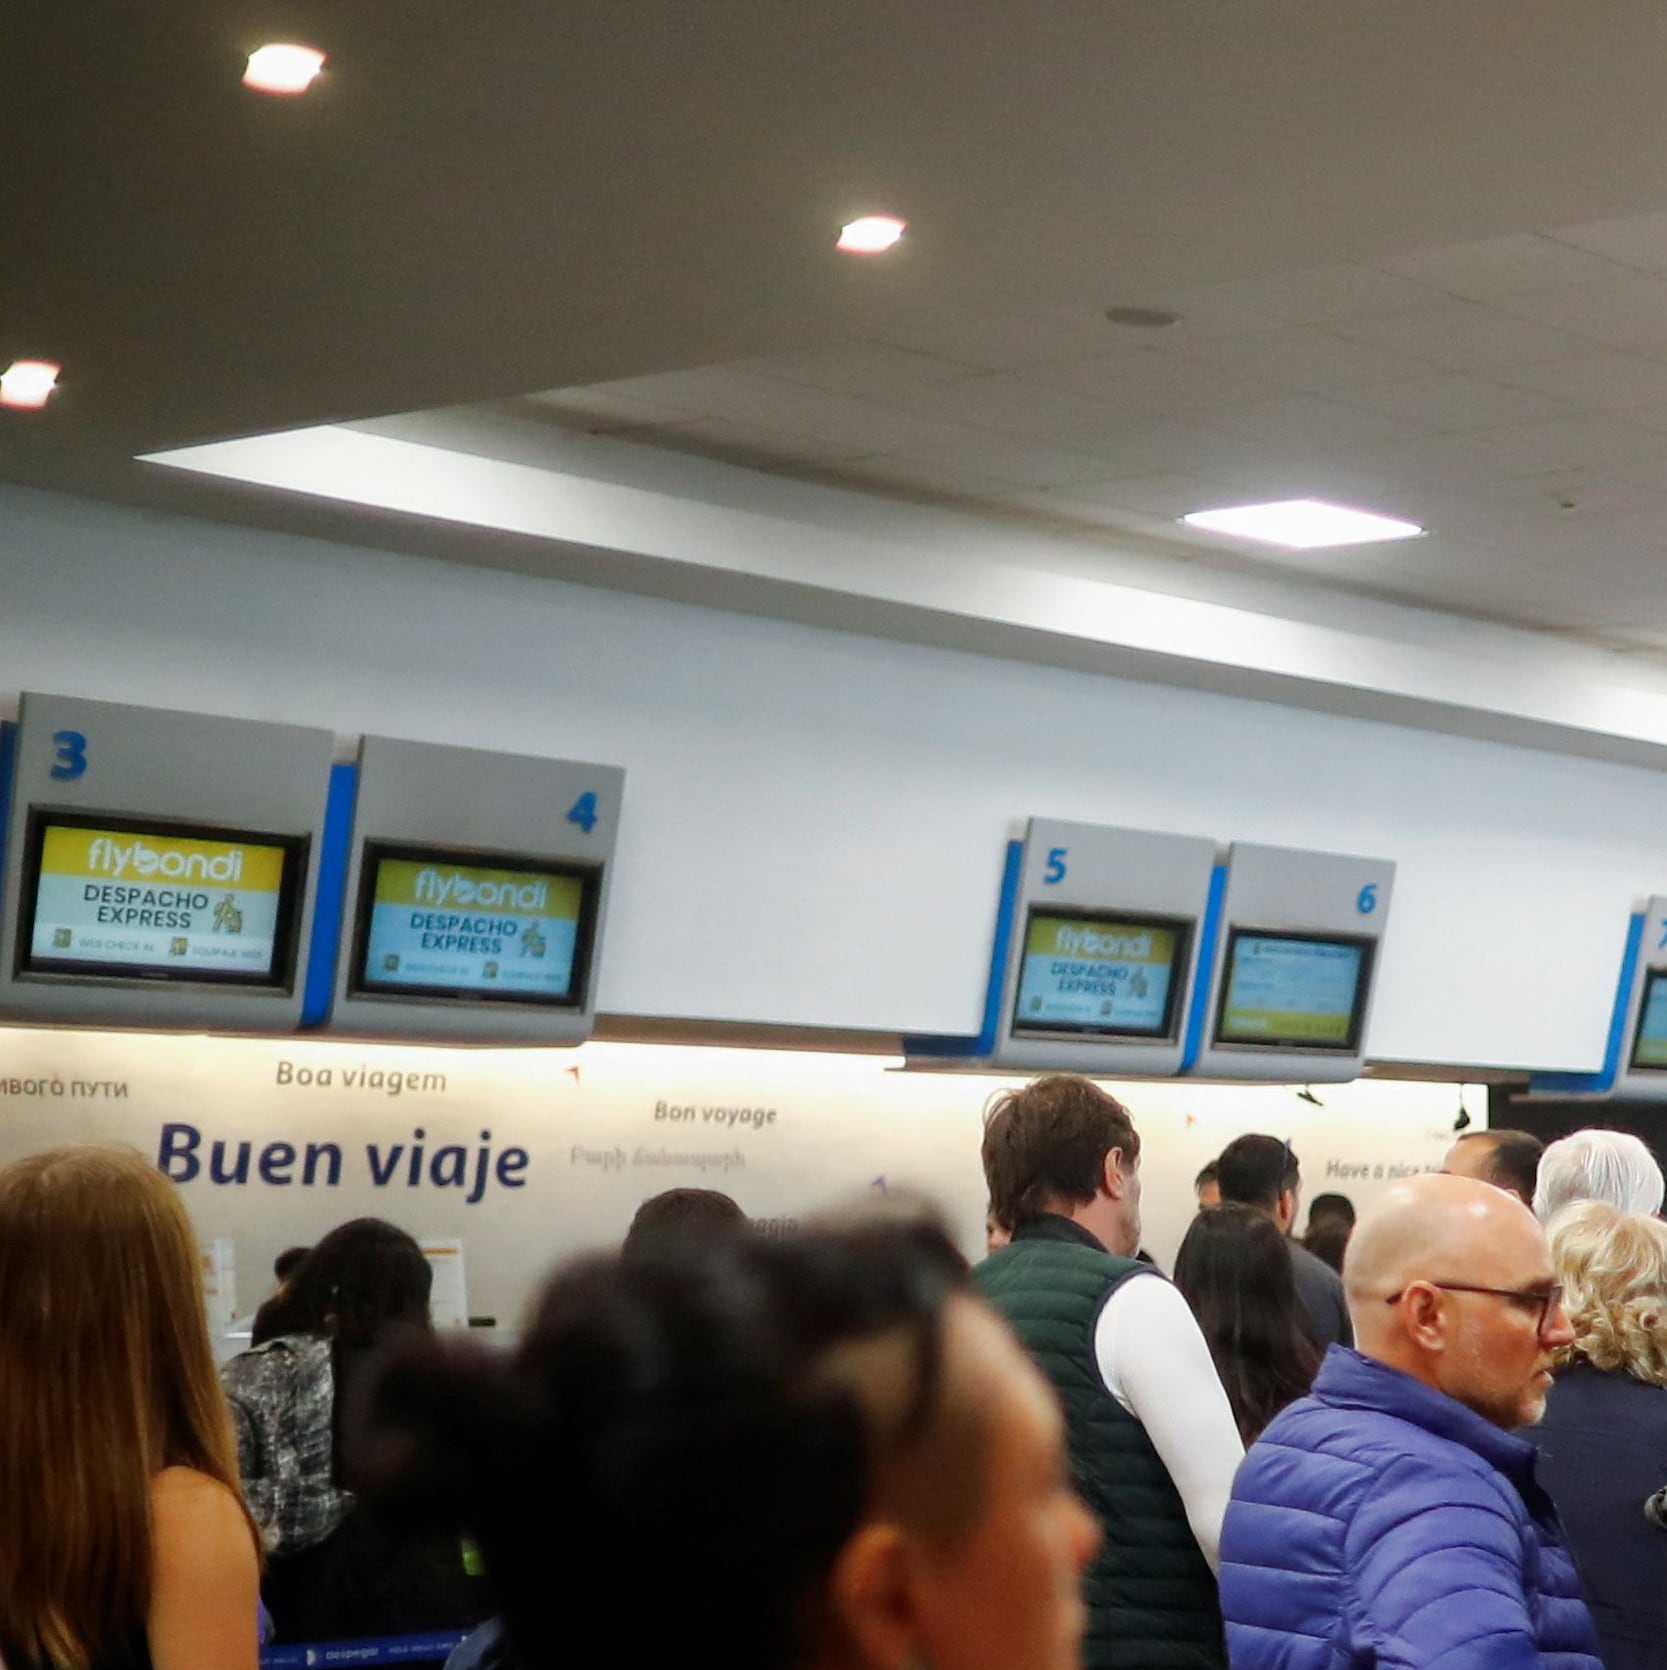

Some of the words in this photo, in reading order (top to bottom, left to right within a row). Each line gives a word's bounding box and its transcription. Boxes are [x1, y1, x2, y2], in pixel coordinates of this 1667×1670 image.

[51, 731, 88, 780] 3
[566, 792, 598, 833] 4
[88, 837, 243, 882] flybondi
[1044, 848, 1068, 884] 5
[84, 884, 209, 911] DESPACHO
[414, 867, 548, 911] flybondi
[1357, 883, 1379, 914] 6
[97, 906, 192, 929] EXPRESS
[410, 912, 518, 937] DESPACHO
[421, 934, 502, 955] EXPRESS
[276, 1061, 333, 1088] Boa
[340, 1064, 447, 1095] viagem
[654, 1100, 696, 1122] Bon
[702, 1105, 778, 1129] voyage
[156, 1123, 340, 1187] Buen
[365, 1127, 530, 1203] viaje
[1326, 1159, 1369, 1178] Have
[1373, 1164, 1384, 1178] a
[326, 1647, 379, 1661] despegar
